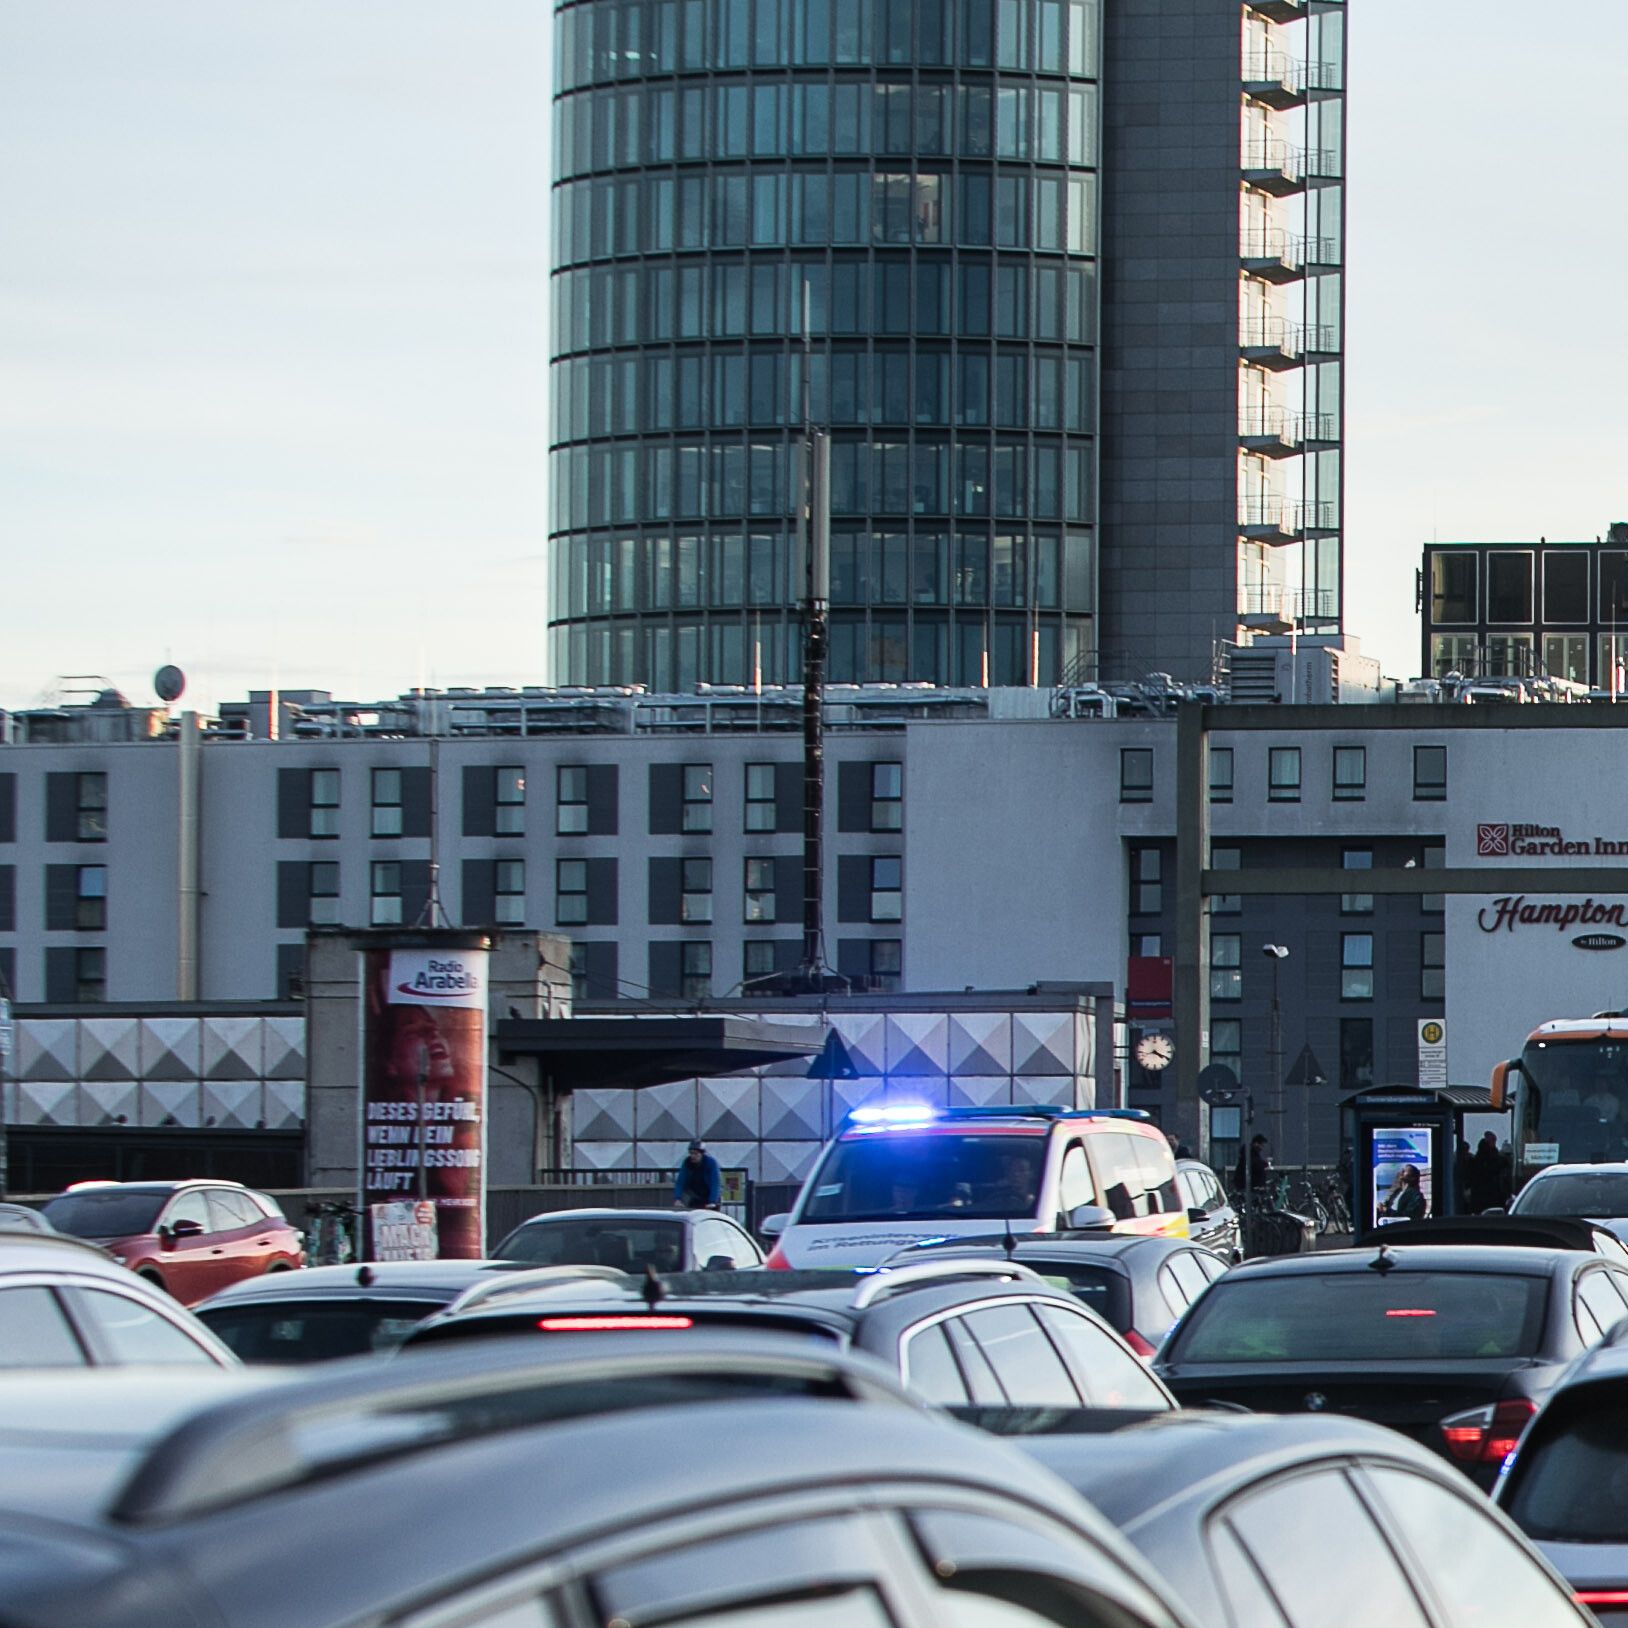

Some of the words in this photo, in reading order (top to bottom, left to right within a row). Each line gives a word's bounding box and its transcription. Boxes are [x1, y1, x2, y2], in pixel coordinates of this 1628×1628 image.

[1511, 823, 1560, 837] Hilton
[1511, 837, 1592, 855] Garden
[428, 960, 463, 972] Radio
[415, 972, 479, 989] Arabella
[367, 1102, 418, 1121] DIESES
[367, 1126, 411, 1144] WENN
[367, 1168, 415, 1190] LÄUFT
[834, 1239, 919, 1249] Rettungs
